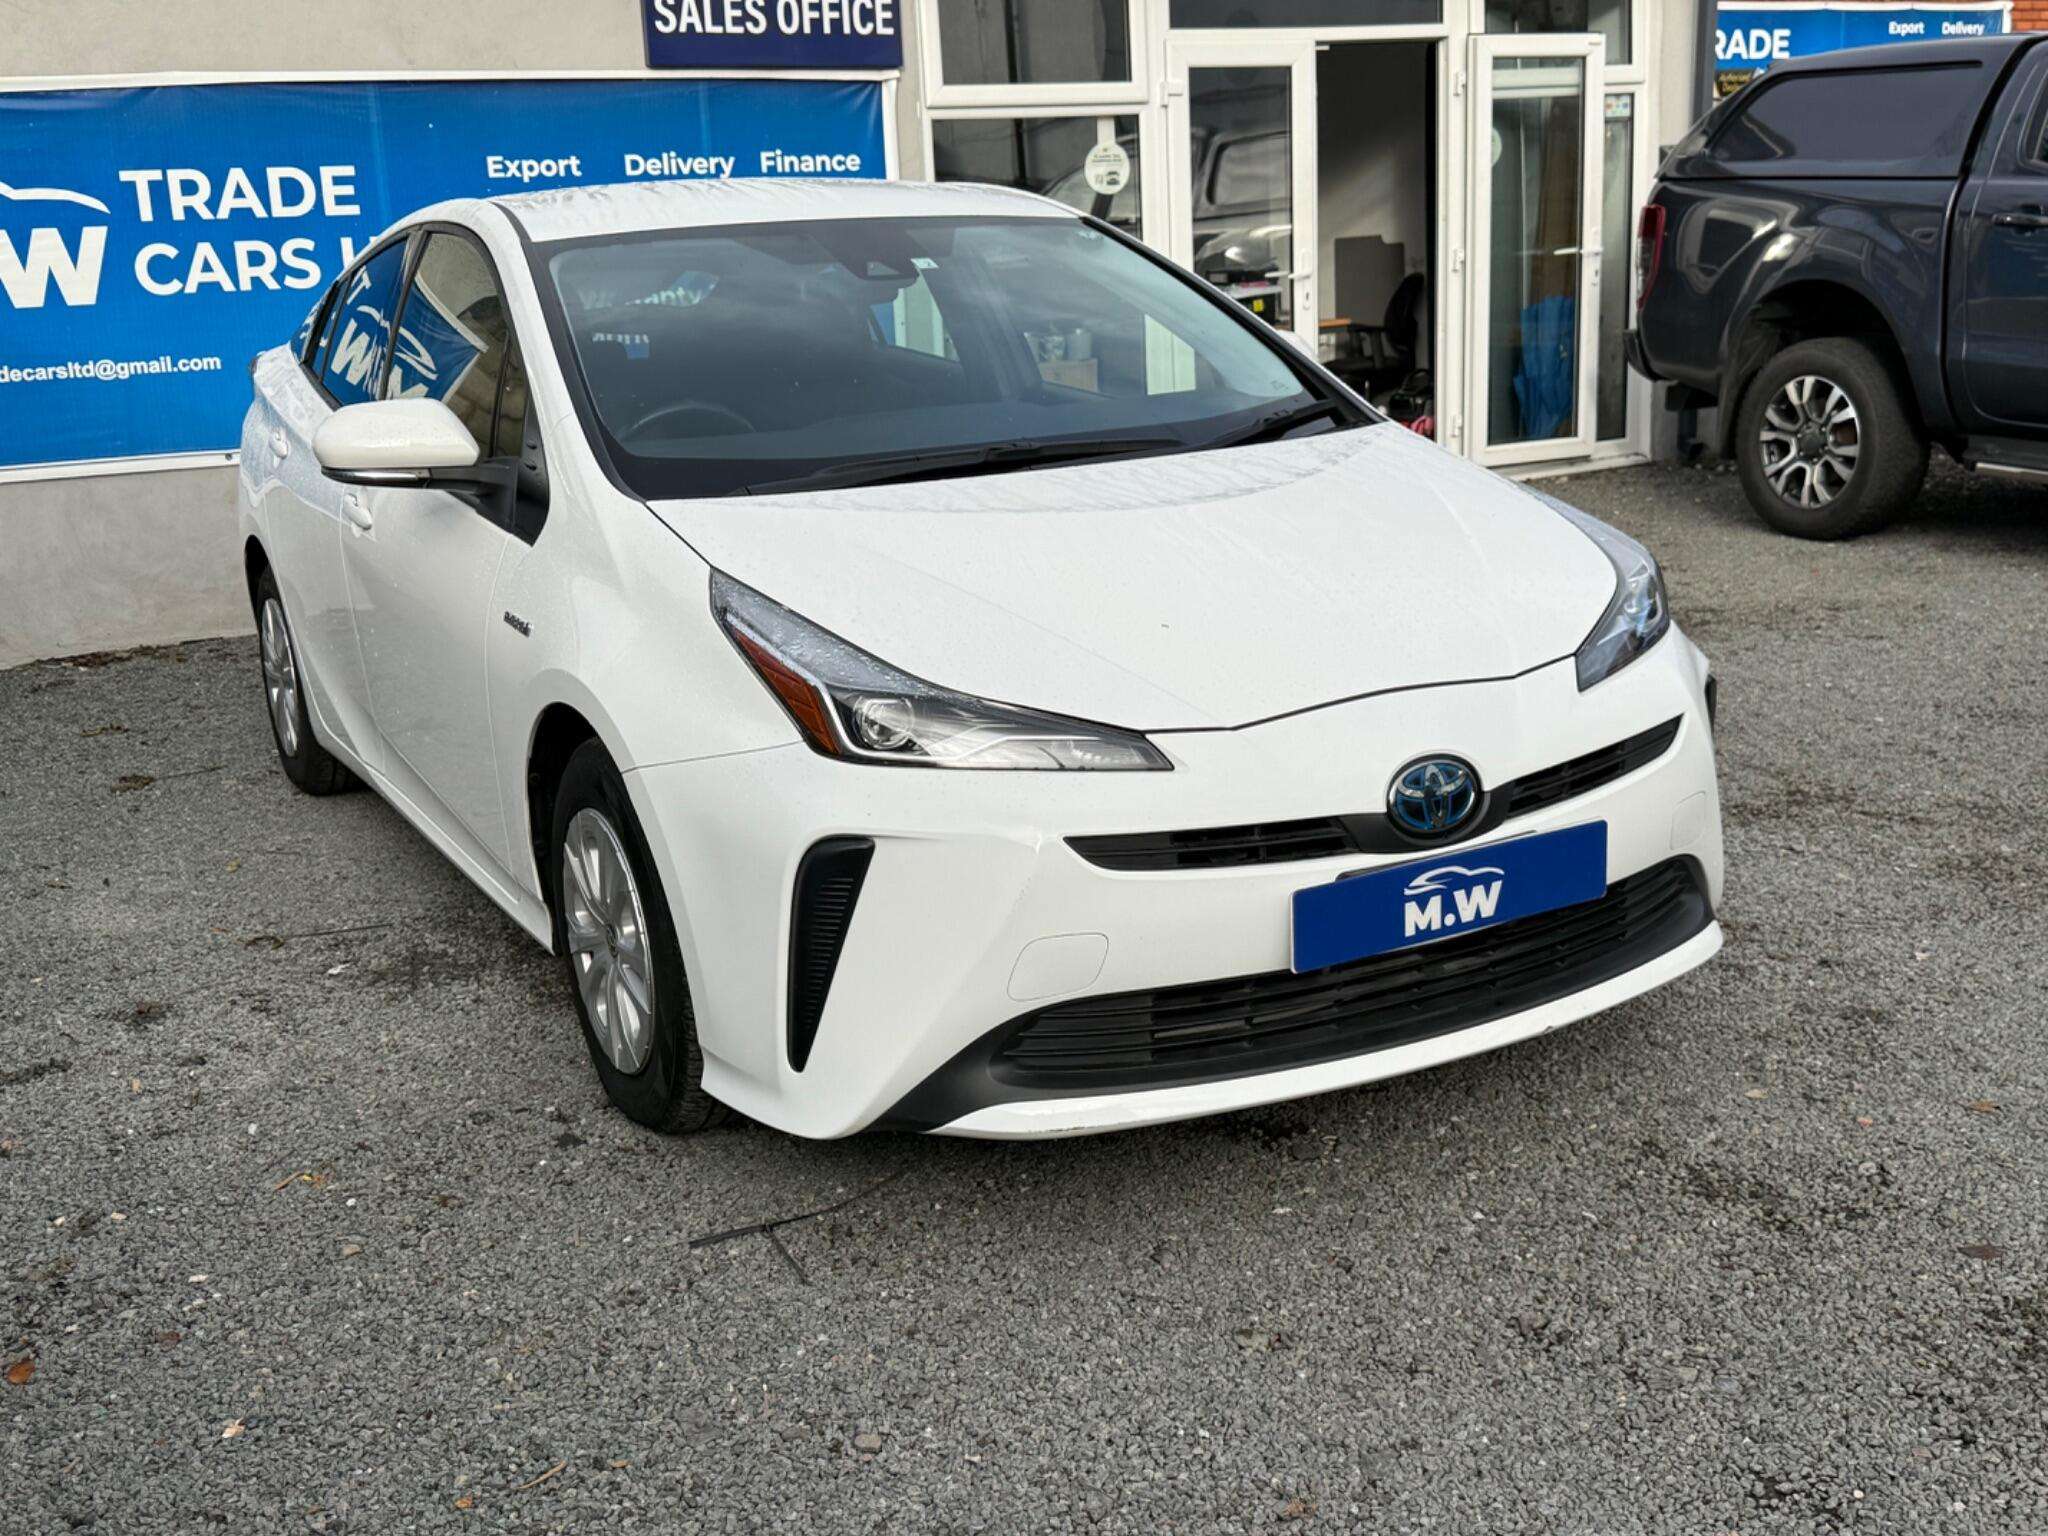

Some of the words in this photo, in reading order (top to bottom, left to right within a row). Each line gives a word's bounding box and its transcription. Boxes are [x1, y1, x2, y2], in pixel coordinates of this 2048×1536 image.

[653, 0, 766, 34] SALES
[776, 0, 894, 35] OFFICE
[1888, 21, 1925, 37] Export
[1941, 21, 1985, 36] Delivery
[486, 155, 582, 182] Export
[624, 151, 735, 178] Delivery
[759, 151, 861, 173] Finance
[119, 165, 361, 222] TRADE
[134, 237, 322, 296] CARS
[1405, 880, 1503, 937] M.W
